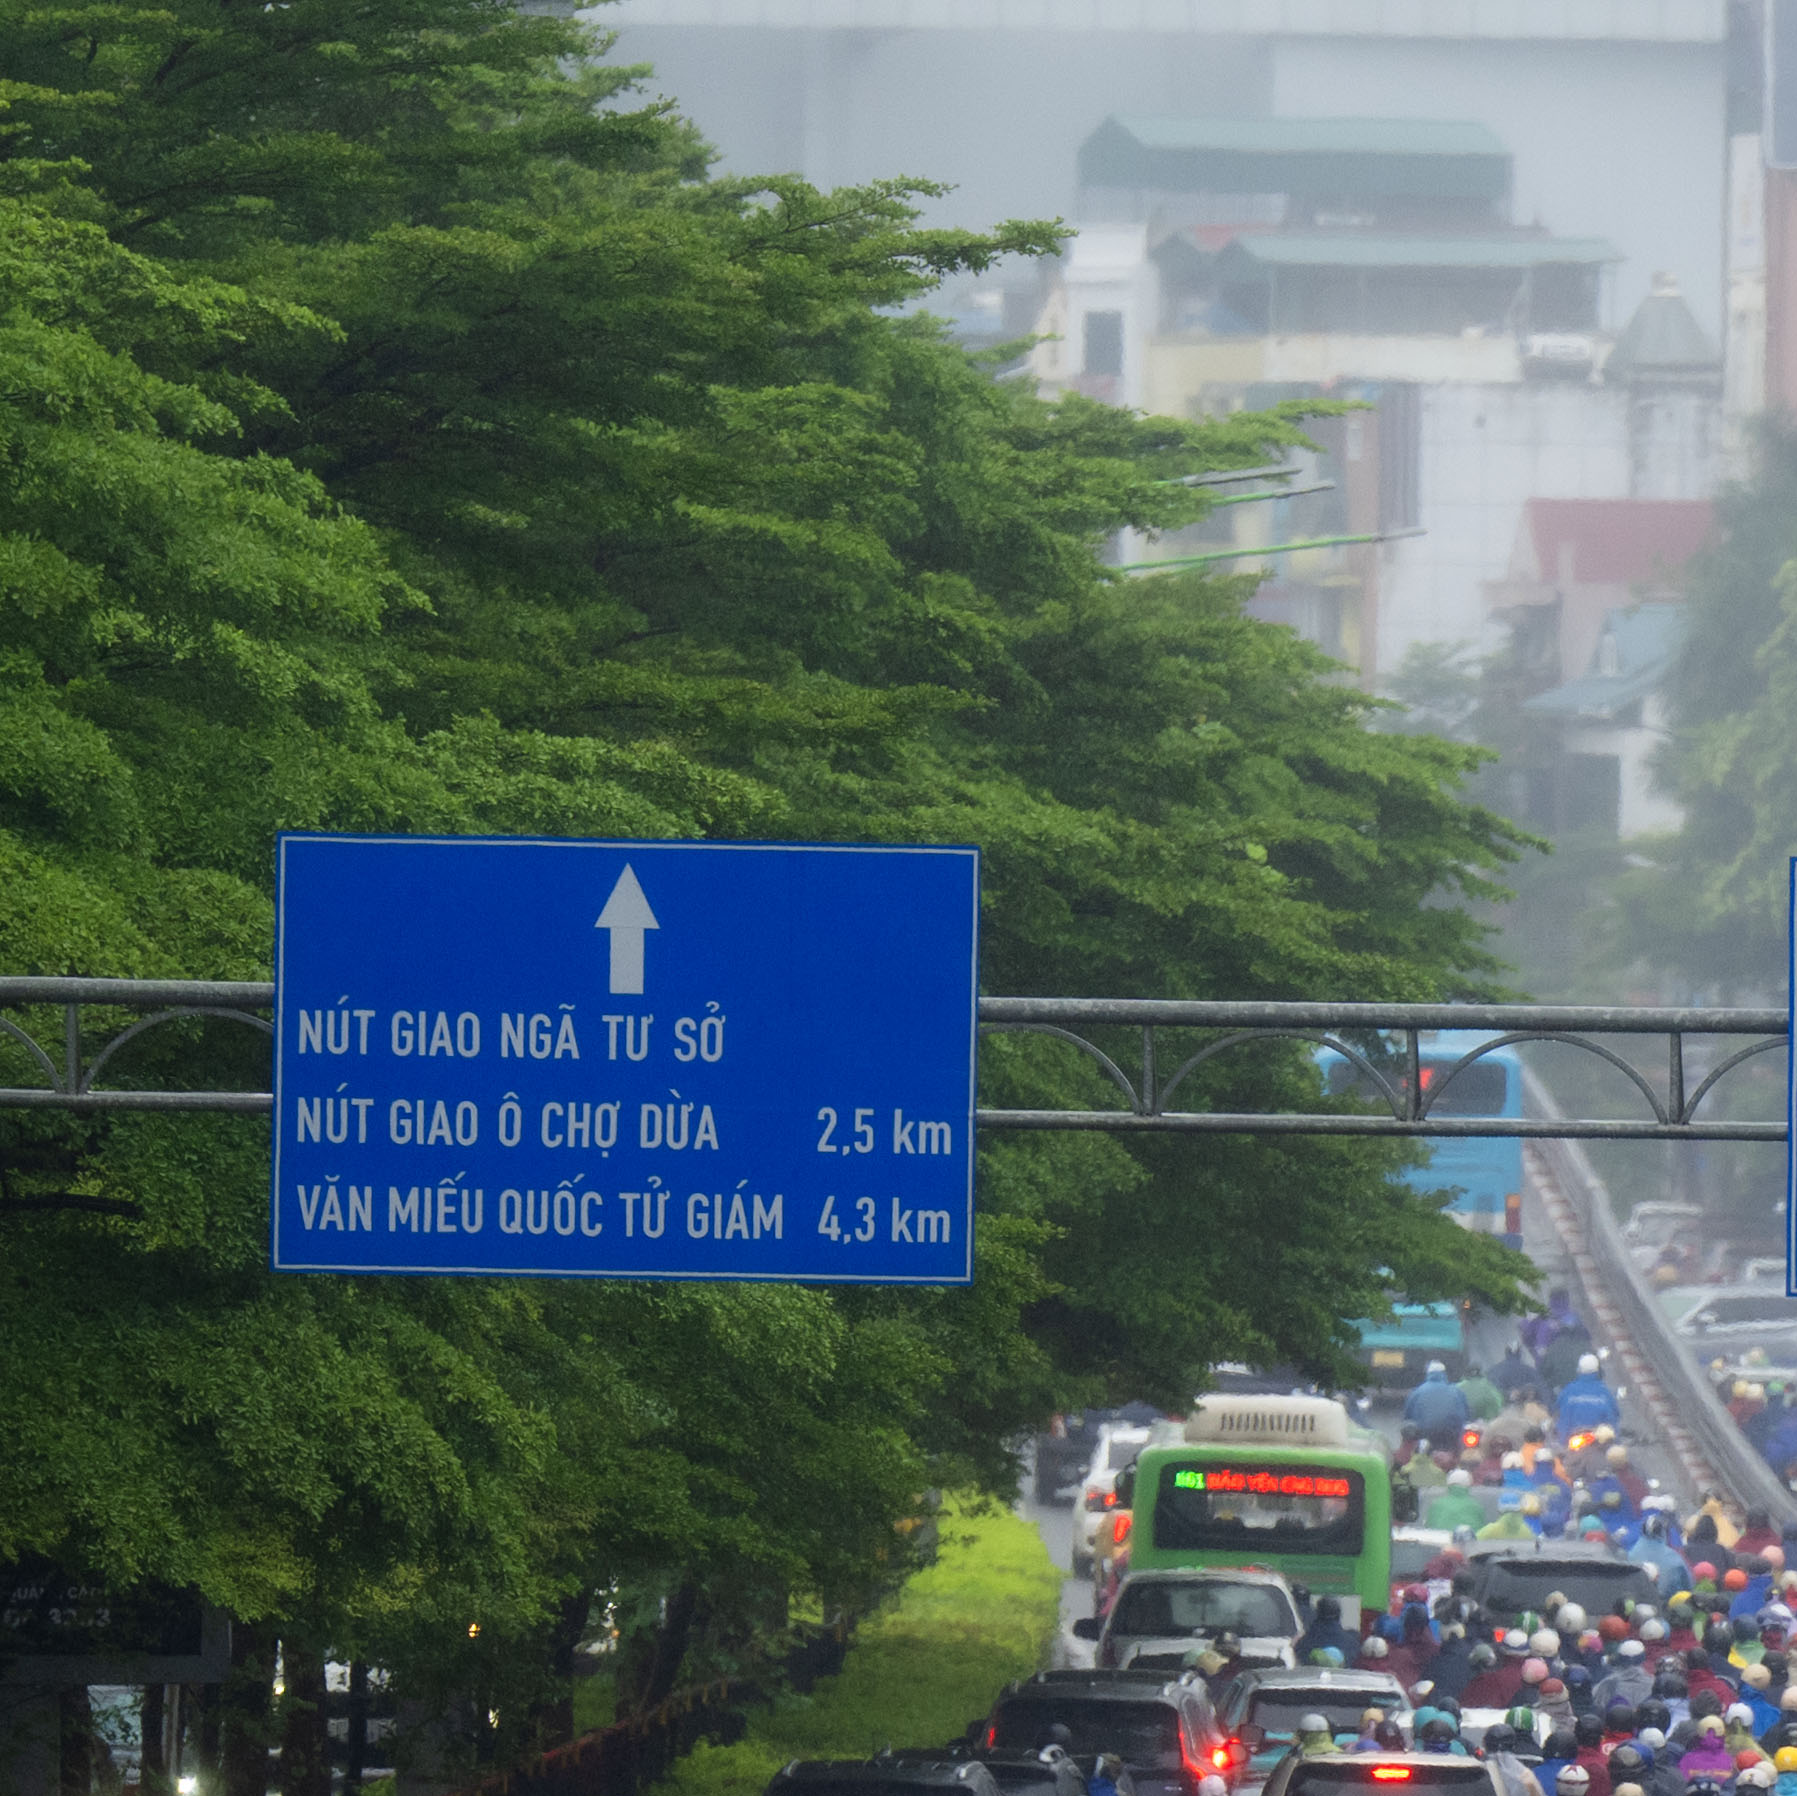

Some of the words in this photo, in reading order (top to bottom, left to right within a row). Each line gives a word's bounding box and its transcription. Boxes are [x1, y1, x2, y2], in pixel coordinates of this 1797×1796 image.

[300, 996, 375, 1054] NÚT
[392, 1011, 480, 1057] GIAO
[502, 1004, 579, 1058] NGÃ
[603, 1015, 653, 1060] TƯ
[675, 1002, 725, 1061] SỞ
[298, 1083, 373, 1143] NÚT
[390, 1100, 477, 1145] GIAO
[499, 1092, 521, 1146] Ô
[542, 1102, 620, 1157] CHỢ
[641, 1090, 718, 1149] DỪA
[818, 1108, 873, 1155] 2,5
[894, 1109, 951, 1154] km
[298, 1176, 372, 1230] VĂN
[389, 1172, 482, 1233] MIẾU
[500, 1174, 602, 1236] QUỐC
[619, 1176, 670, 1238] TỬ
[688, 1180, 782, 1239] GIÁM
[819, 1196, 874, 1243] 4,3
[892, 1198, 950, 1242] km
